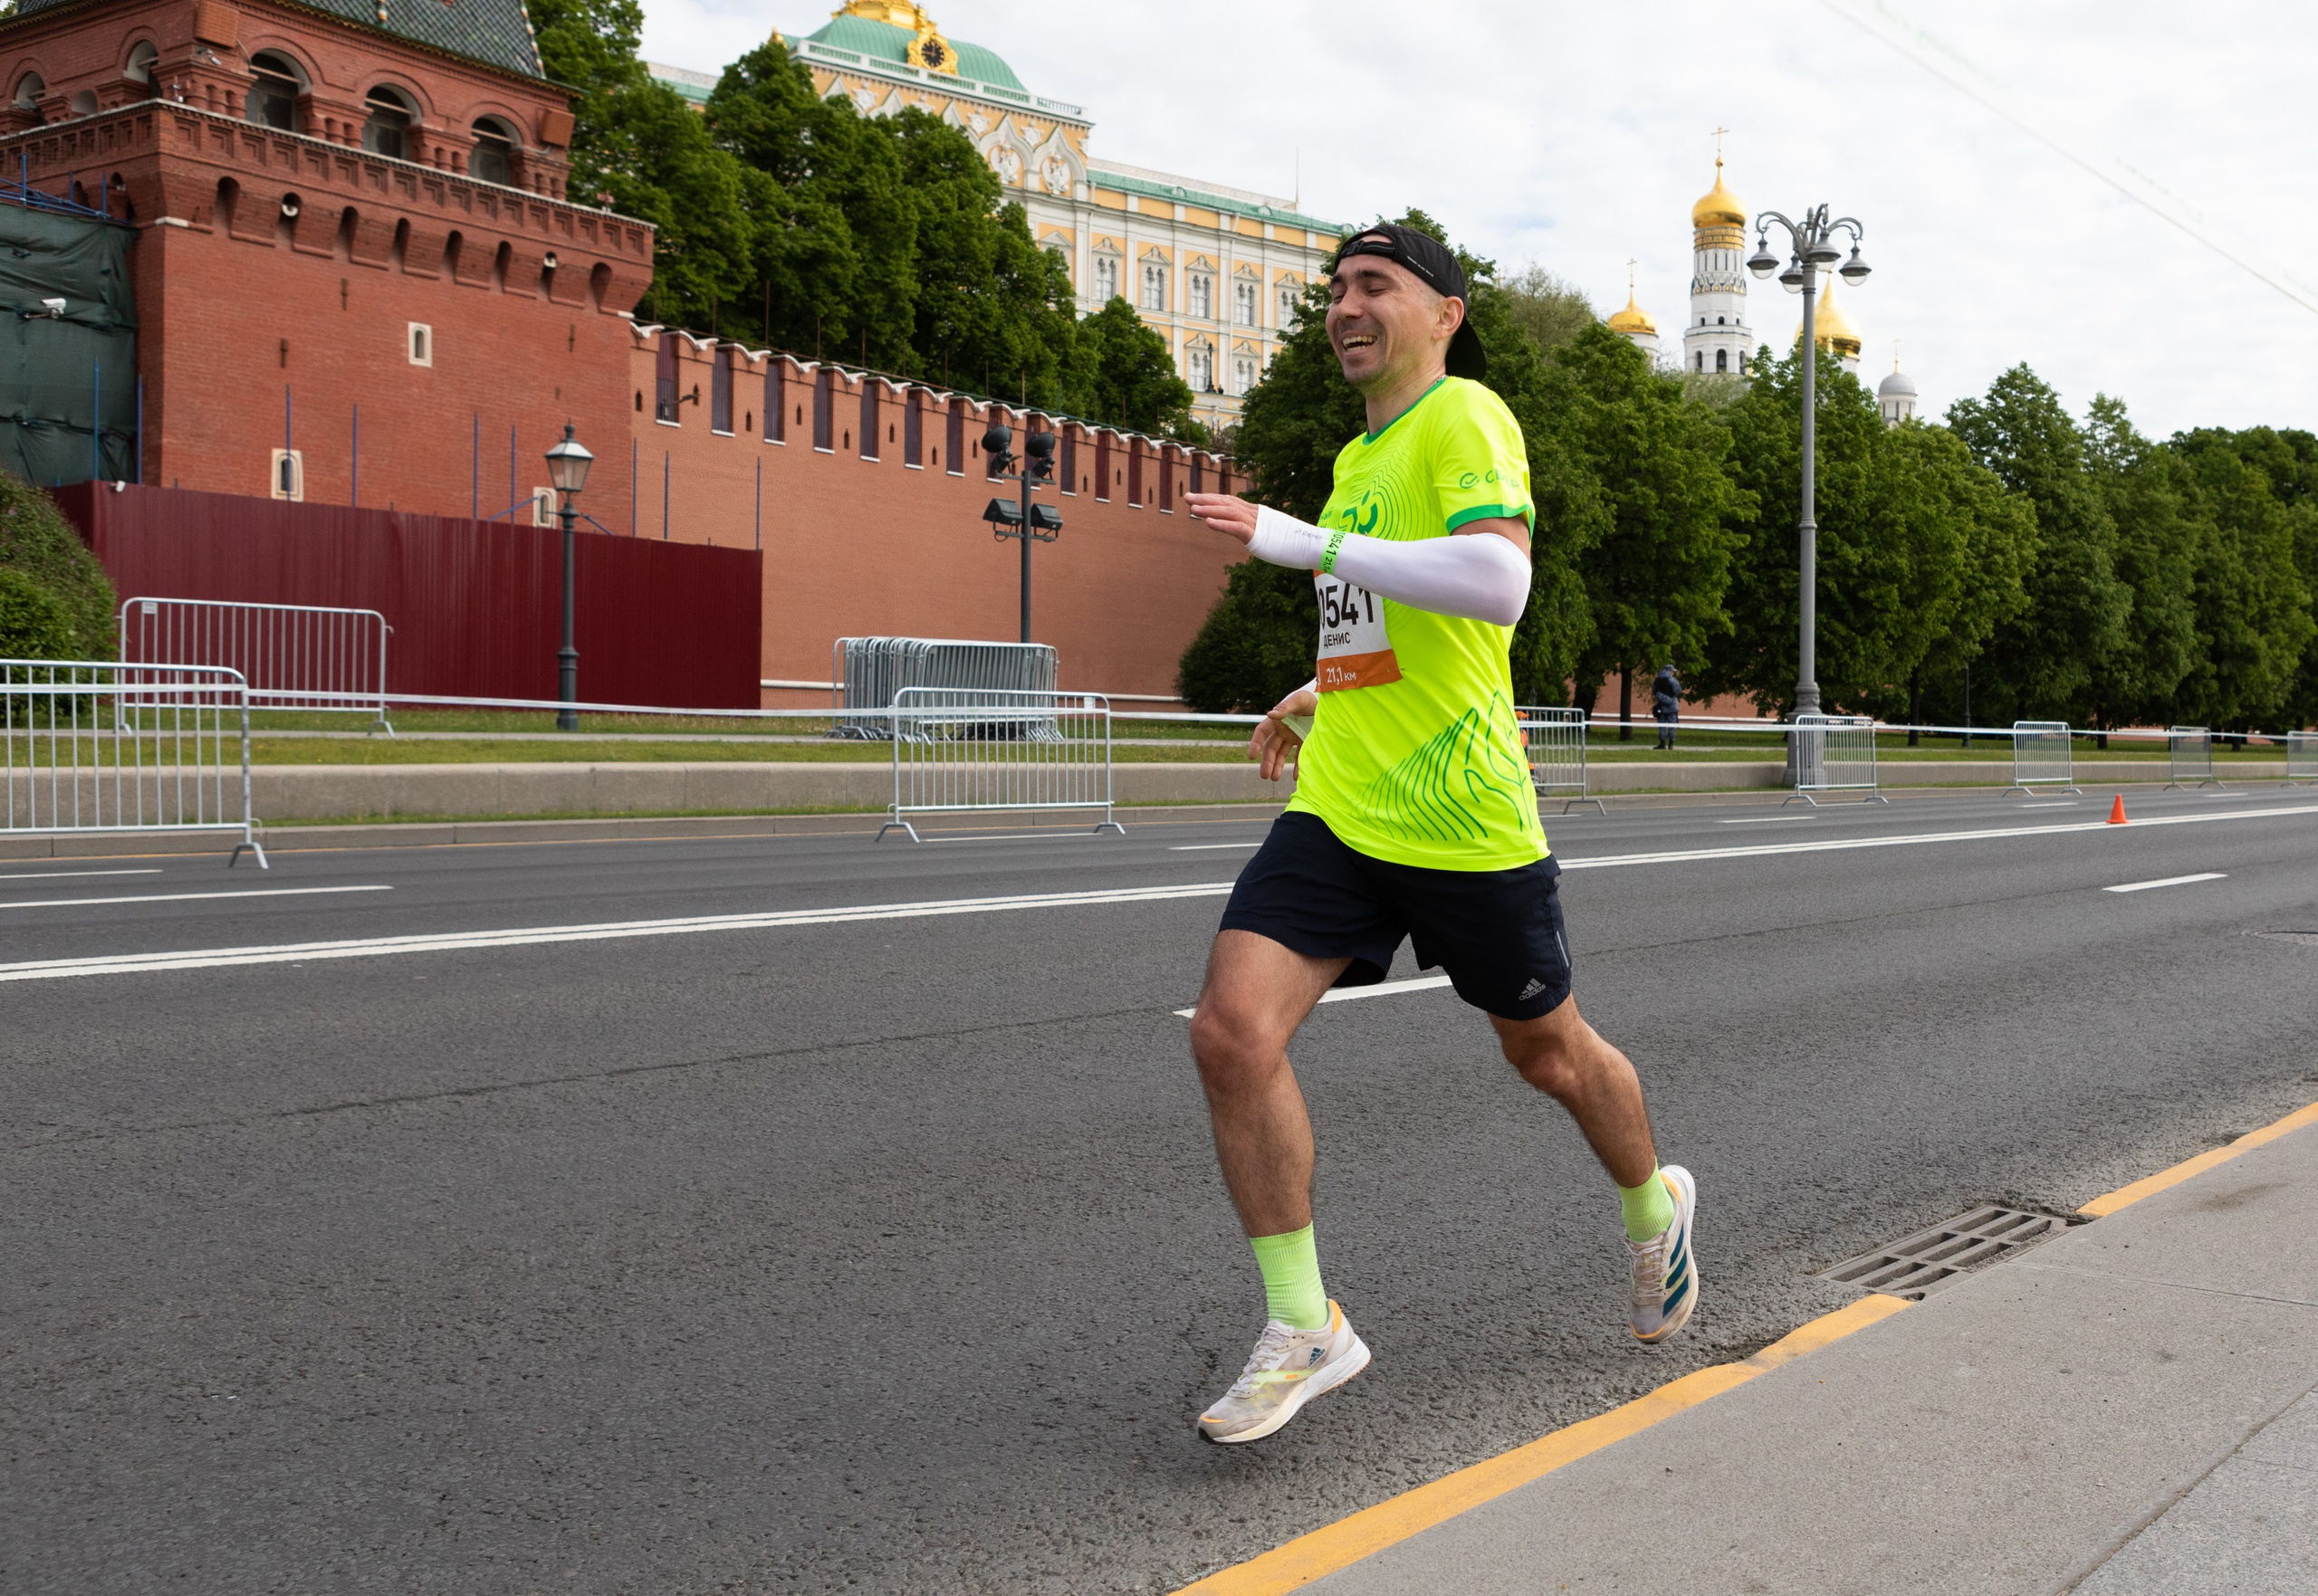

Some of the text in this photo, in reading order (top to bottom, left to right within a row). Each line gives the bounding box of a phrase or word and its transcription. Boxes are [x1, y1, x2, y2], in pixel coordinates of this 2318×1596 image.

[1324, 632, 1351, 649] ДЕНИС
[1327, 666, 1344, 685] 21,1
[1518, 983, 1546, 1000] adidas
